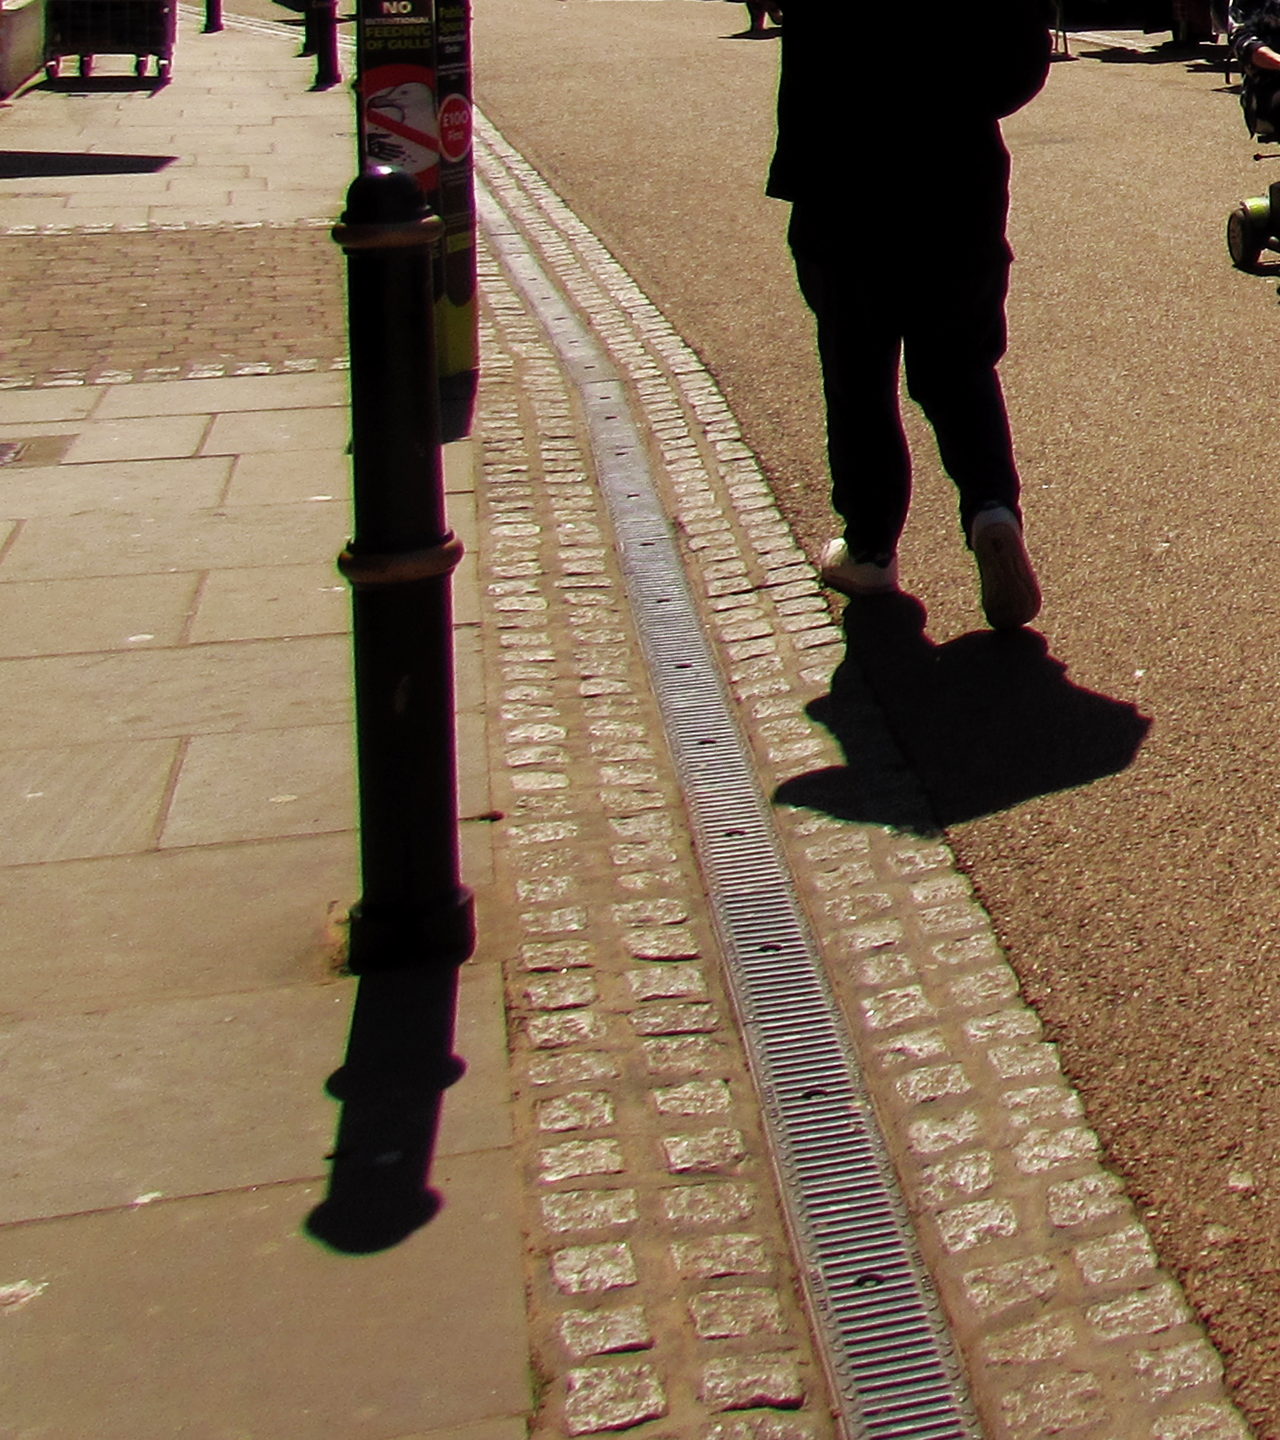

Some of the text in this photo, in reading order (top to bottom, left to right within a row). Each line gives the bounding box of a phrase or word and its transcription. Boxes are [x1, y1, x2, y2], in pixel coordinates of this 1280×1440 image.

[383, 0, 414, 15] NO
[365, 26, 432, 38] FEEDING
[365, 38, 432, 51] OF GULLS
